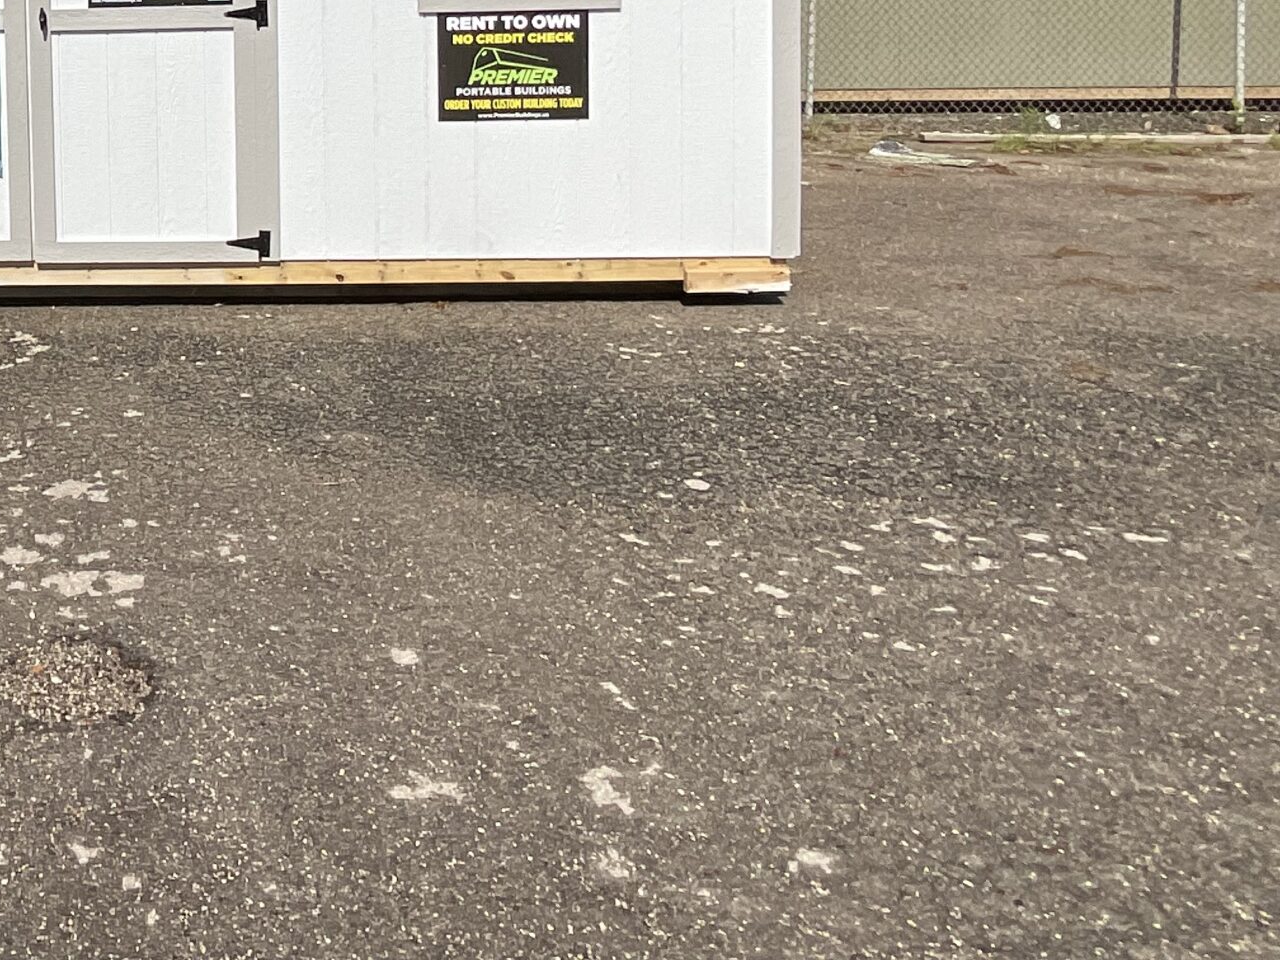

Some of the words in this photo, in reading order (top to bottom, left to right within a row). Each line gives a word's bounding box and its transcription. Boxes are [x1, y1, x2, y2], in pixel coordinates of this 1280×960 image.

[446, 16, 497, 31] RENT
[501, 16, 528, 29] TO
[531, 14, 580, 28] OWN
[452, 34, 473, 45] NO
[476, 33, 525, 45] CREDIT
[527, 32, 574, 43] CHECK
[468, 69, 558, 85] PREMIER
[456, 87, 512, 96] PORTABLE
[514, 86, 572, 95] BUILDINGS
[444, 100, 469, 110] ORDER
[471, 99, 491, 109] YOUR
[492, 99, 521, 109] CUSTOM
[523, 98, 557, 108] BUILDING
[559, 98, 583, 108] TODAY
